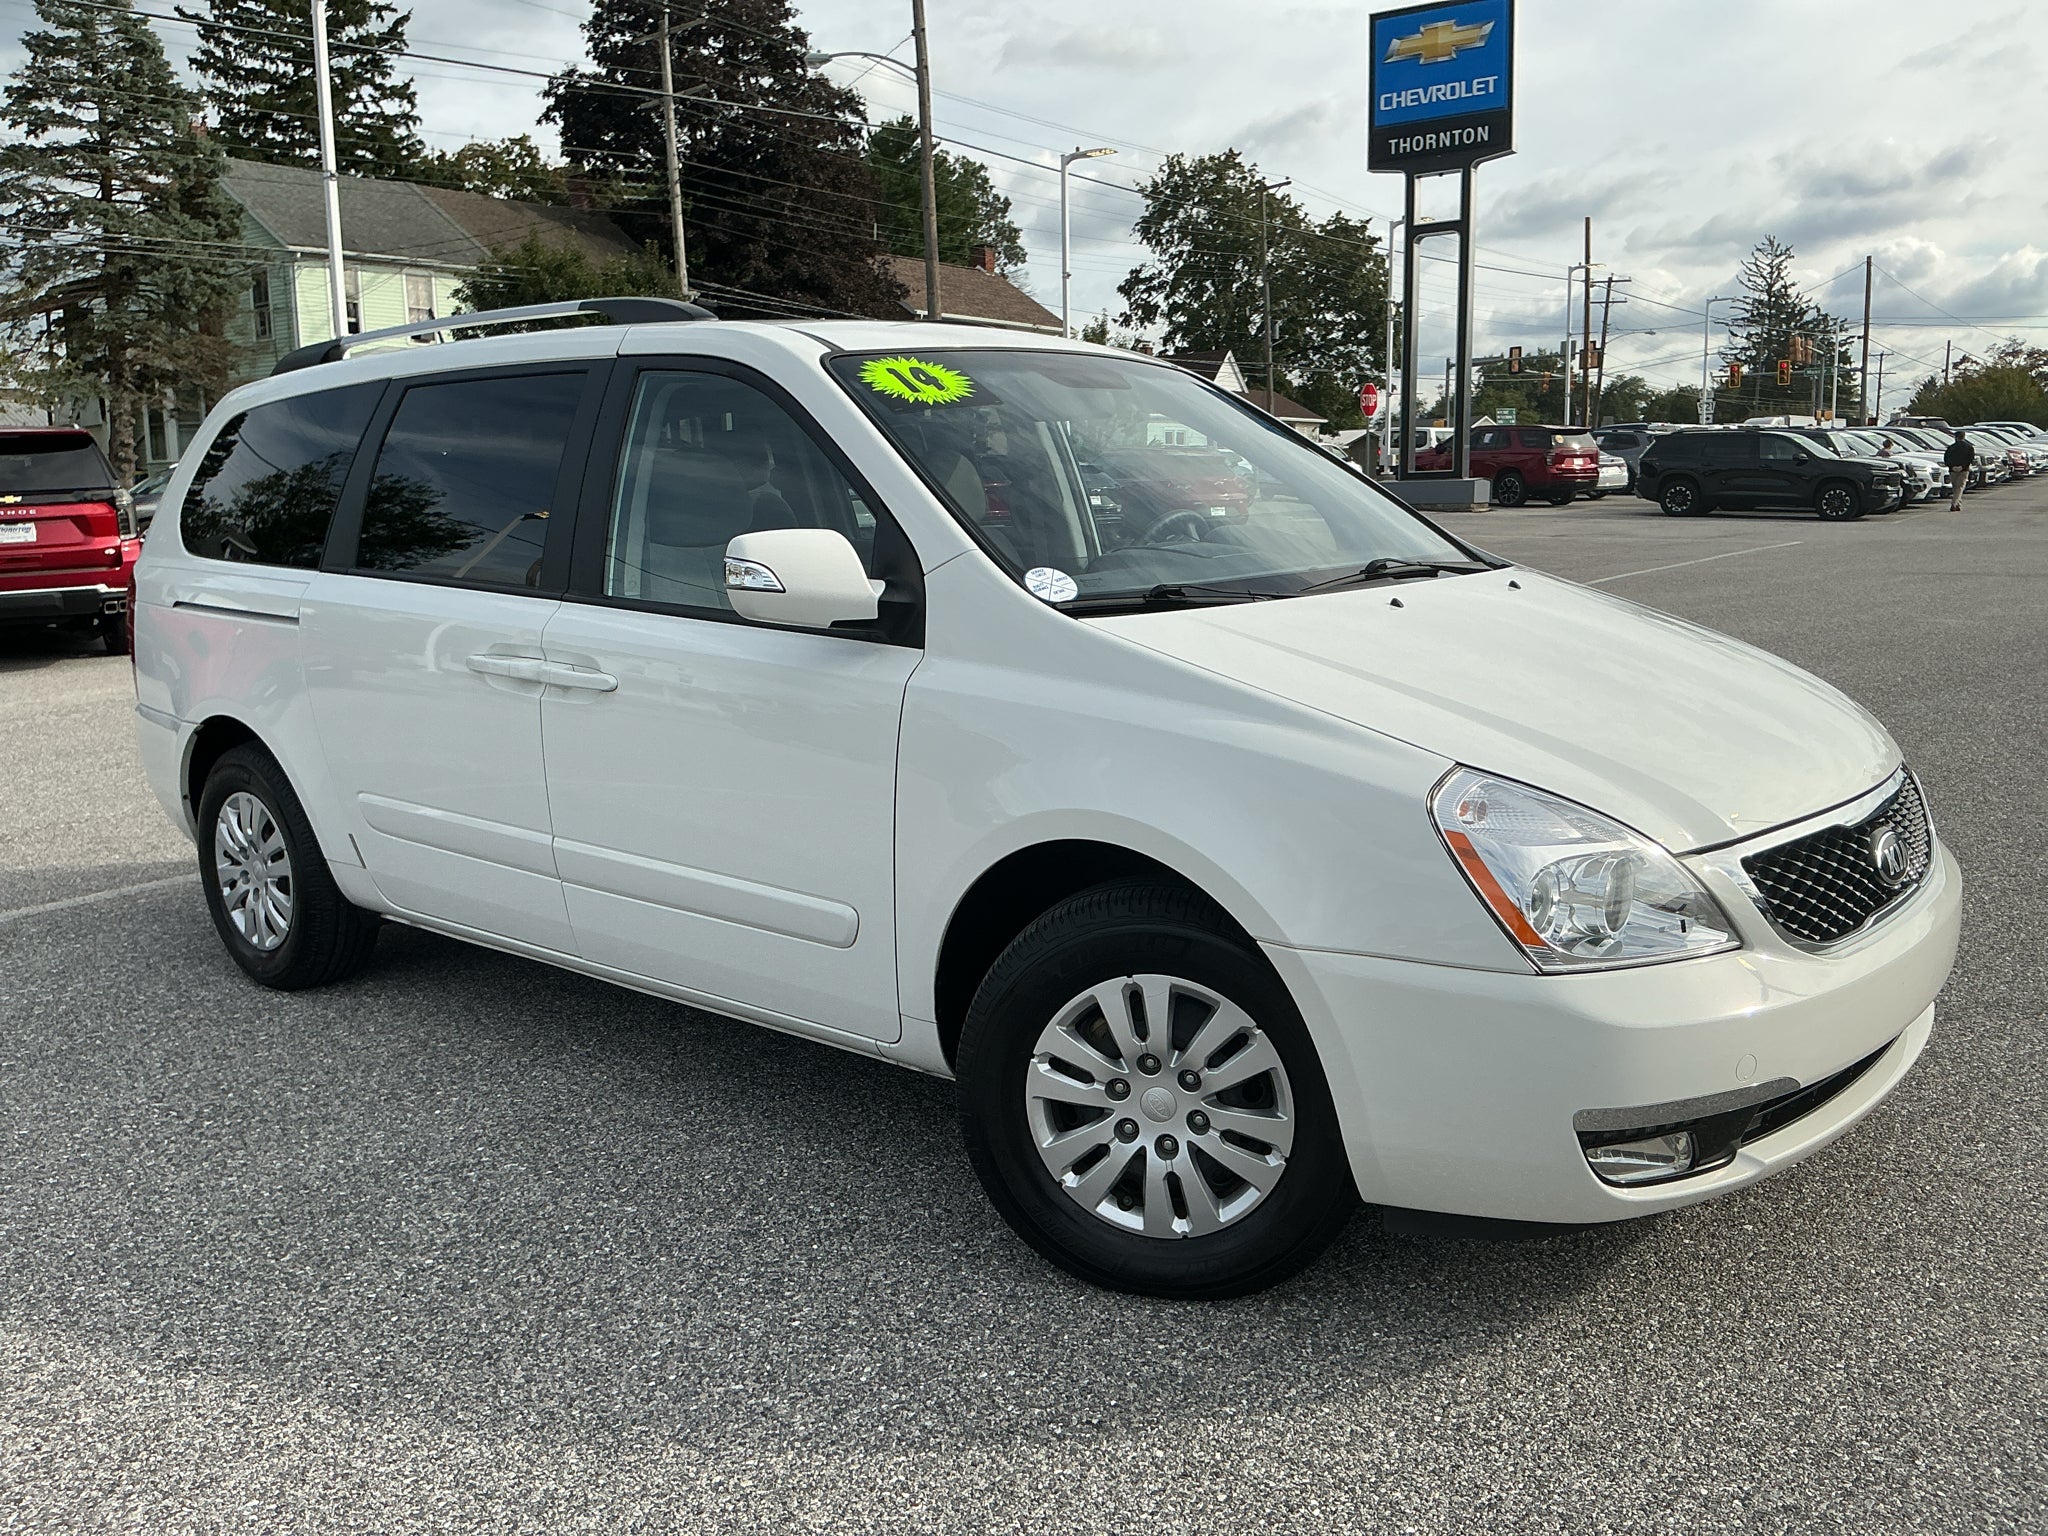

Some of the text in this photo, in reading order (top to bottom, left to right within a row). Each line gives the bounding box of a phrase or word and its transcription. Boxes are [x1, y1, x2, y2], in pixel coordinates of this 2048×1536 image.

[1379, 75, 1498, 111] CHEVROLET
[1388, 125, 1489, 155] THORNTON
[886, 366, 950, 394] 14
[1361, 393, 1377, 407] STOP
